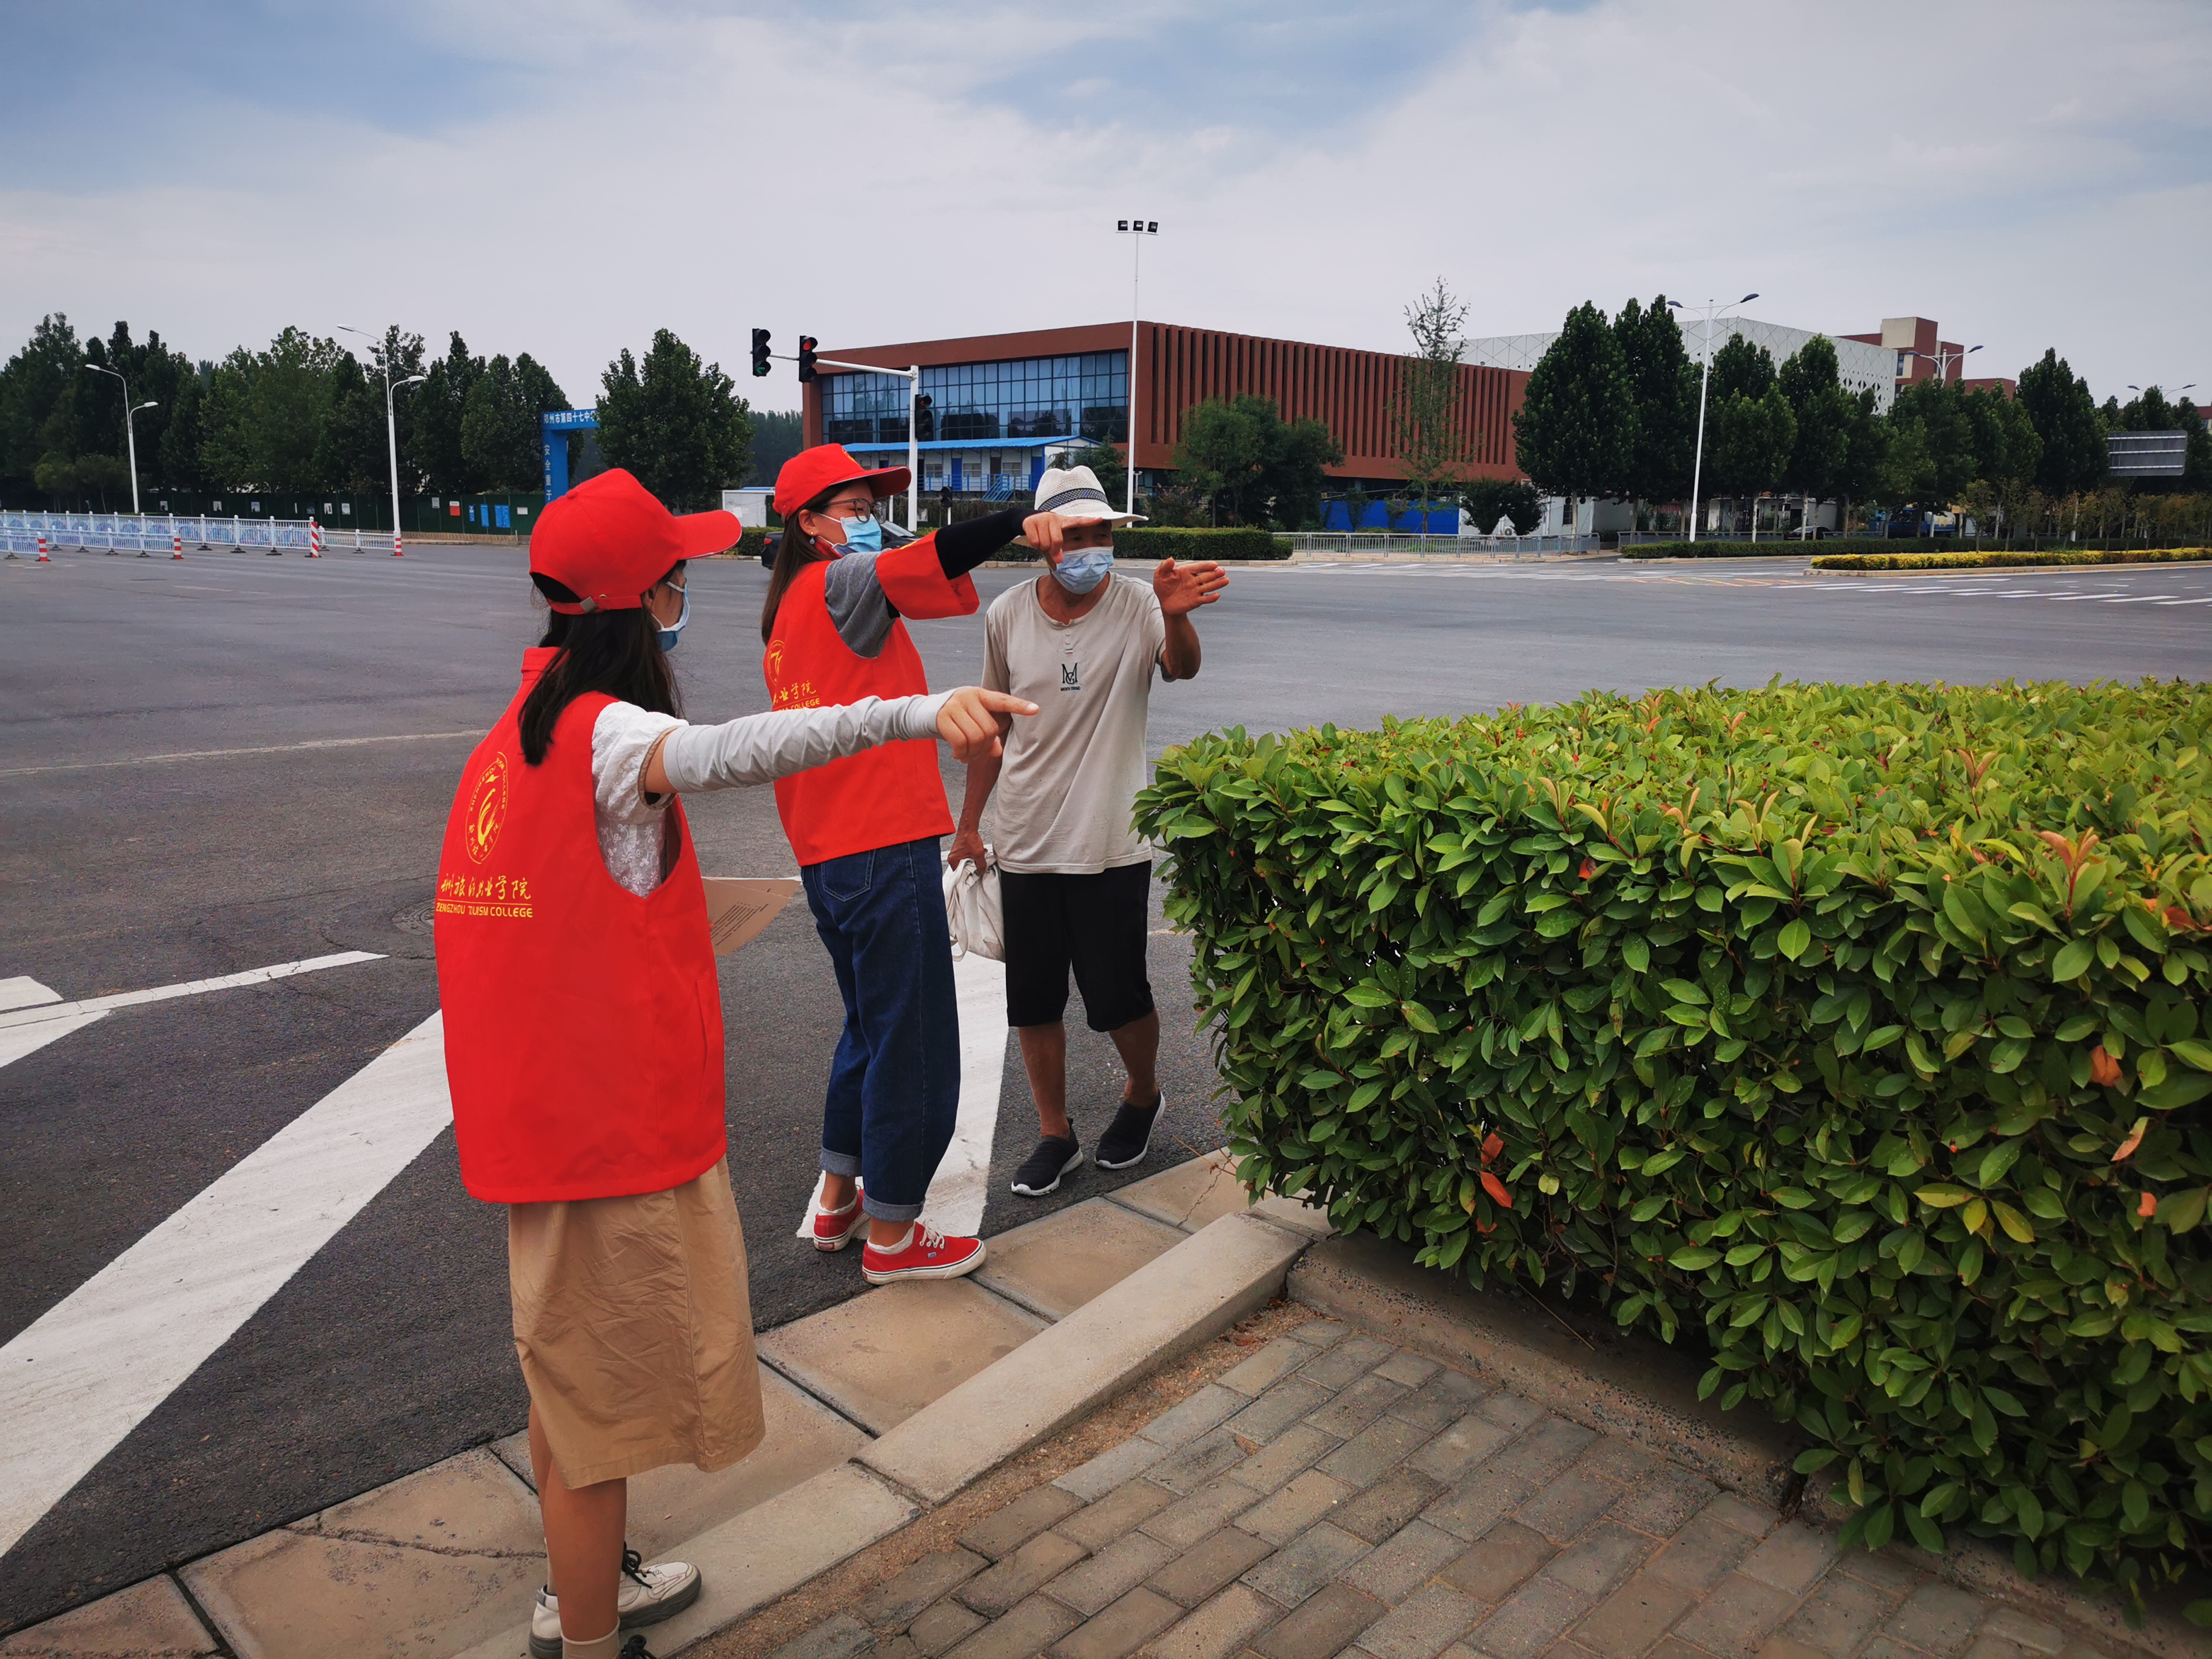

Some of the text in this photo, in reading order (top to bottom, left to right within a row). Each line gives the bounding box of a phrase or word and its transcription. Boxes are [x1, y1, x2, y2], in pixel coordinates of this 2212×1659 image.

[543, 411, 601, 424] 郑州市第四十七中学
[791, 698, 820, 711] COLLEGE
[490, 907, 533, 918] COLLEGE
